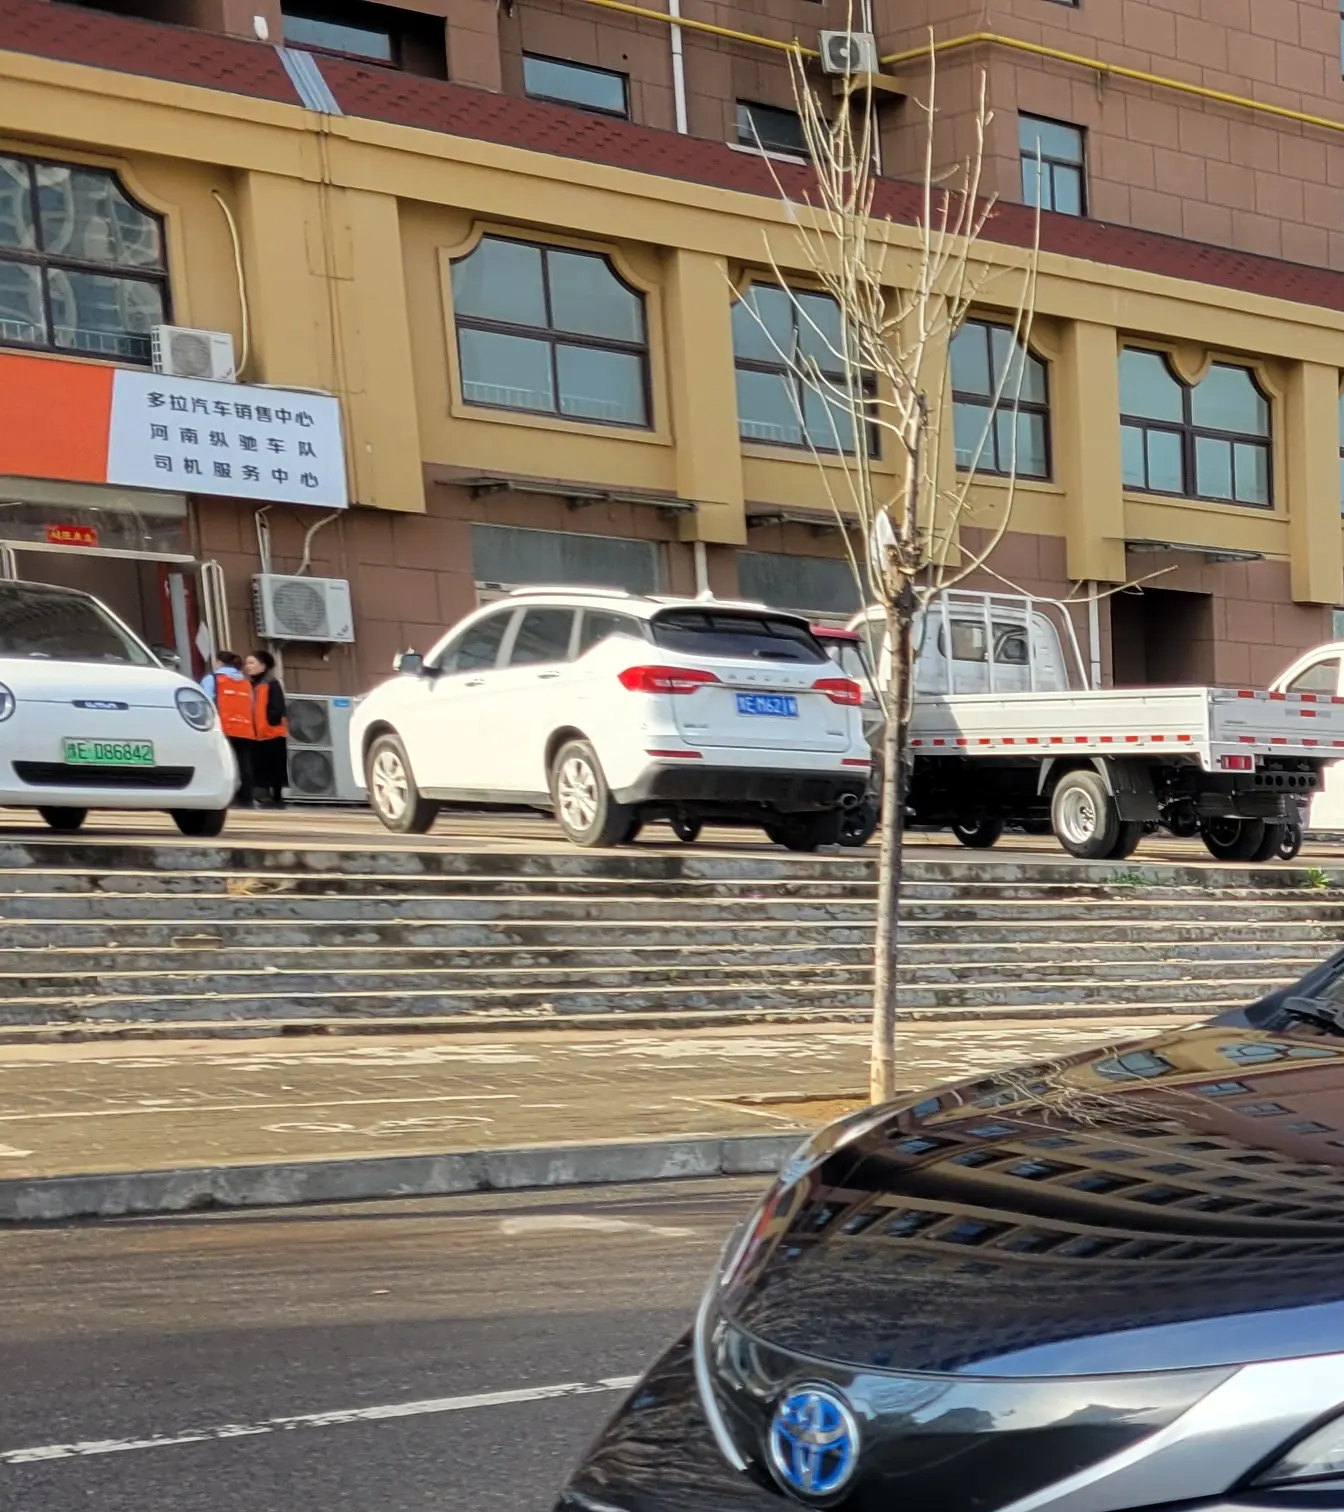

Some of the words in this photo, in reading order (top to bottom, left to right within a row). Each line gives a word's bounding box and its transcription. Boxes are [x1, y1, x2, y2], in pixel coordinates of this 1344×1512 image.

[147, 391, 315, 428] 多拉汽车销售中心
[150, 422, 317, 458] 河南纵驰车队
[153, 454, 319, 488] 司机服务中心
